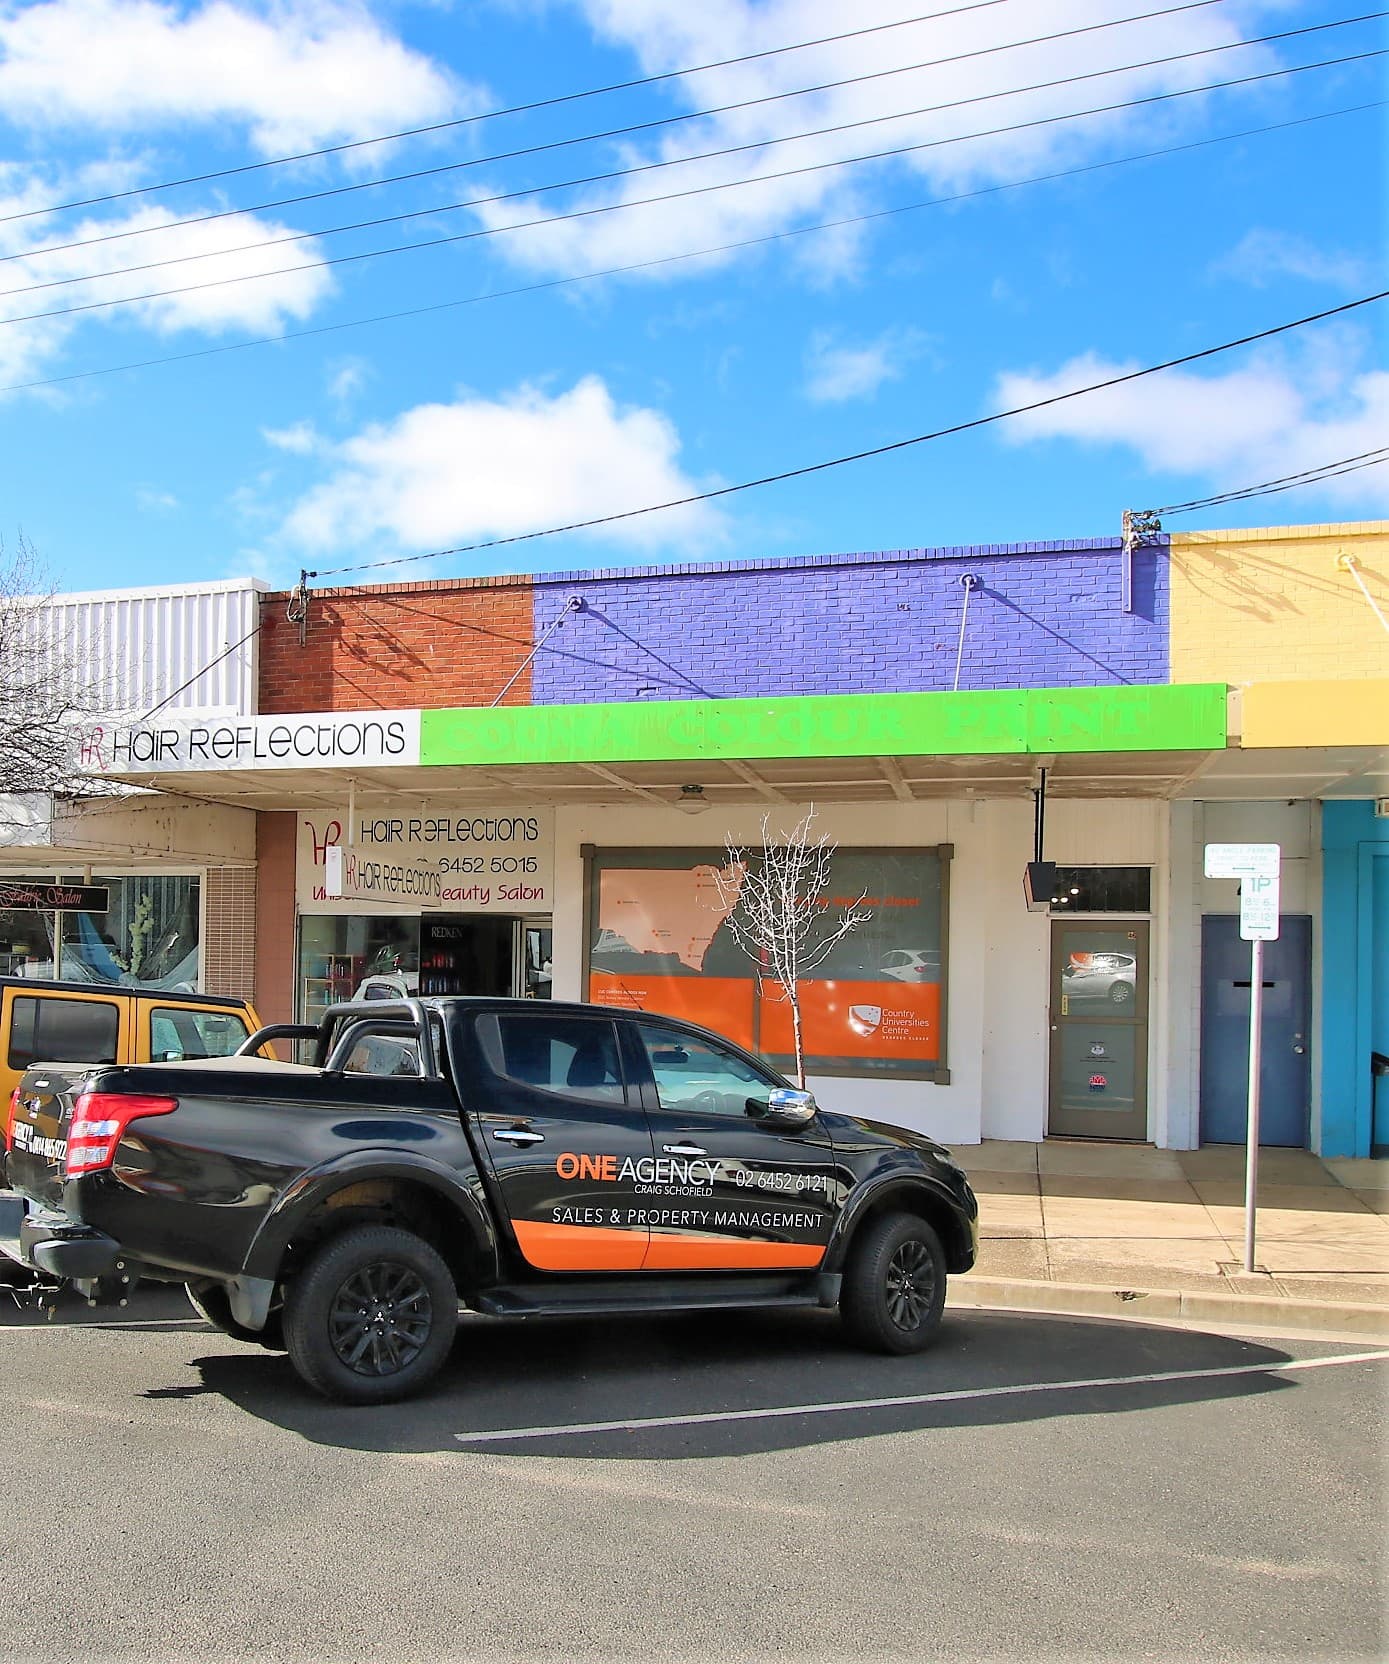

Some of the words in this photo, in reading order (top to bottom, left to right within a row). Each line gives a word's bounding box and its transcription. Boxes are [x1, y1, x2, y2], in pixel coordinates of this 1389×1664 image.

[943, 701, 1152, 738] PRINT
[439, 857, 485, 873] 6452
[490, 856, 538, 873] 5015
[441, 884, 490, 905] eauty
[497, 882, 544, 901] Salon
[881, 1009, 915, 1019] Country
[881, 1018, 930, 1027] Universities
[881, 1026, 909, 1035] Centre
[735, 1169, 754, 1187] 02
[757, 1171, 792, 1190] 6452
[795, 1173, 827, 1192] 6121
[634, 1184, 662, 1194] CRAIG
[664, 1185, 713, 1197] SCHOFIELD
[552, 1206, 603, 1223] SALES
[609, 1208, 620, 1224] &
[627, 1209, 710, 1225] PROPERTY
[714, 1210, 824, 1228] MANAGEMENT
